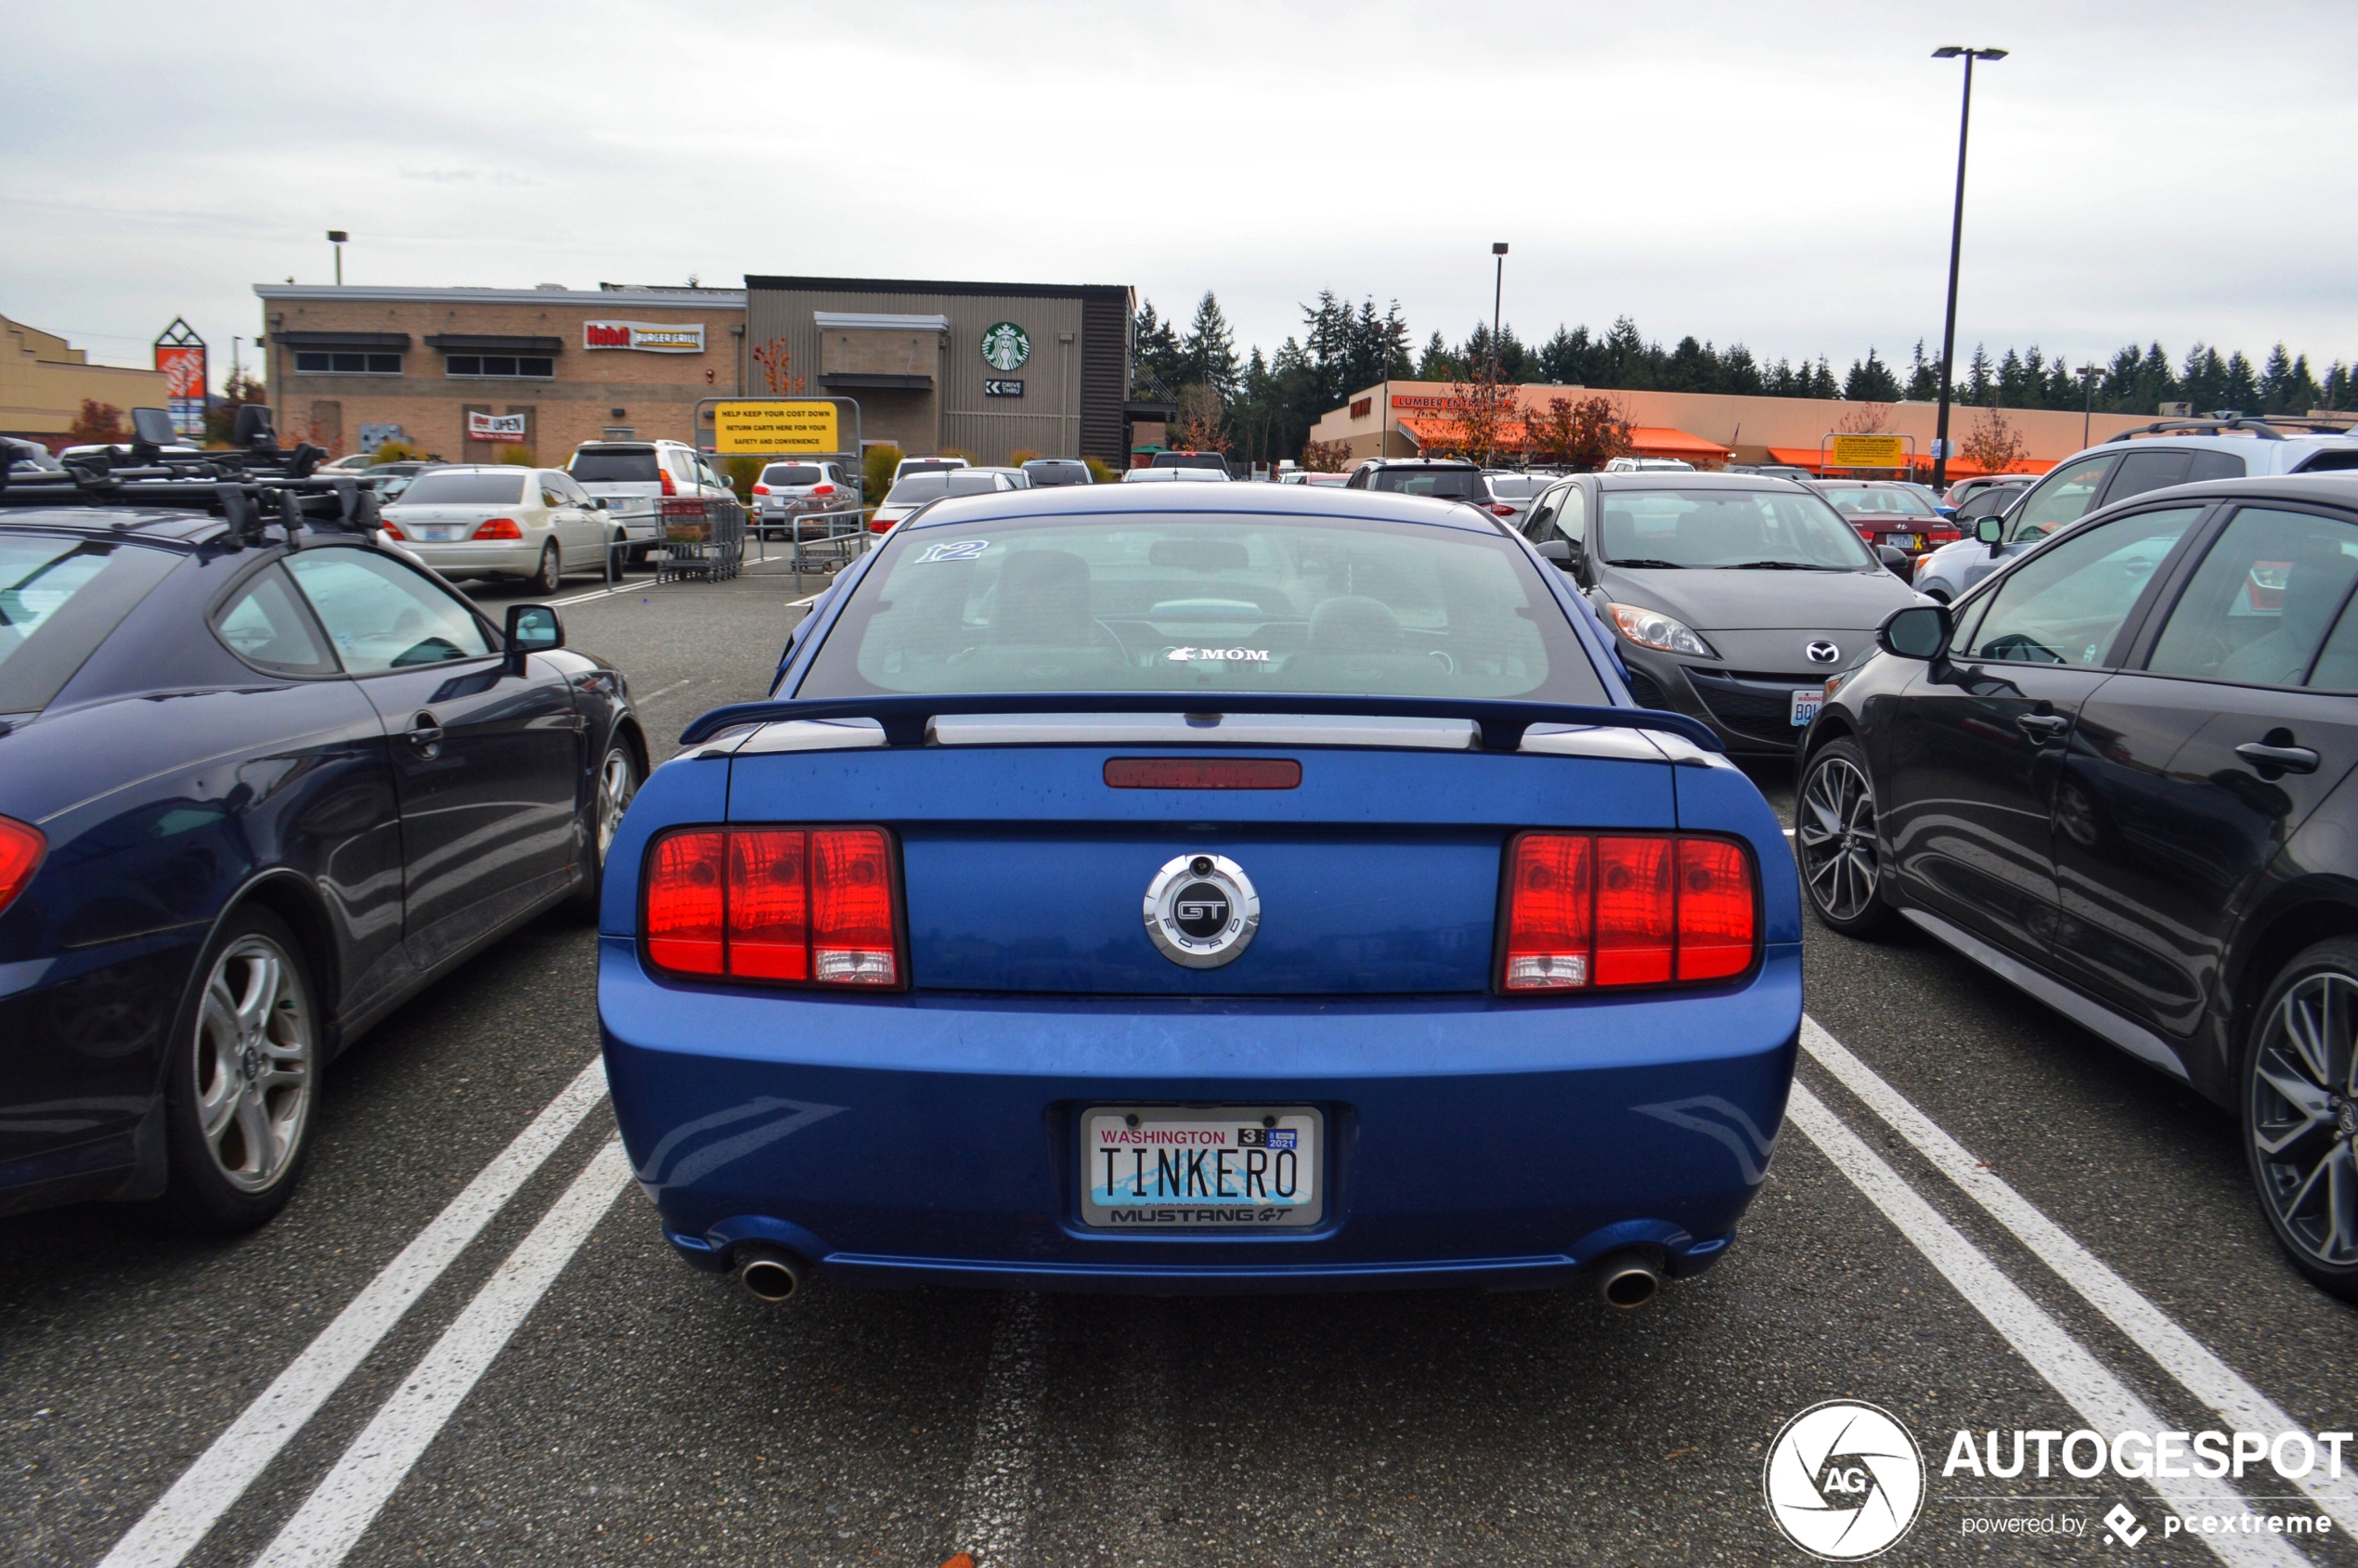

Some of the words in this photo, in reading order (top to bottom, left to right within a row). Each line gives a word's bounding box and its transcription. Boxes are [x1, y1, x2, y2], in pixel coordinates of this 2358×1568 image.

[587, 324, 630, 346] Habit
[635, 333, 671, 343] BURGER
[672, 333, 697, 343] GRILL
[1399, 397, 1443, 408] LUMBER
[1200, 649, 1270, 661] MOM
[1178, 901, 1226, 920] GT
[1101, 1130, 1225, 1145] WASHINGTON
[1243, 1129, 1256, 1143] 3
[1269, 1139, 1294, 1148] 2021
[1100, 1147, 1298, 1198] TINKERO
[1111, 1208, 1253, 1223] MUSTANG
[1258, 1208, 1292, 1222] GT
